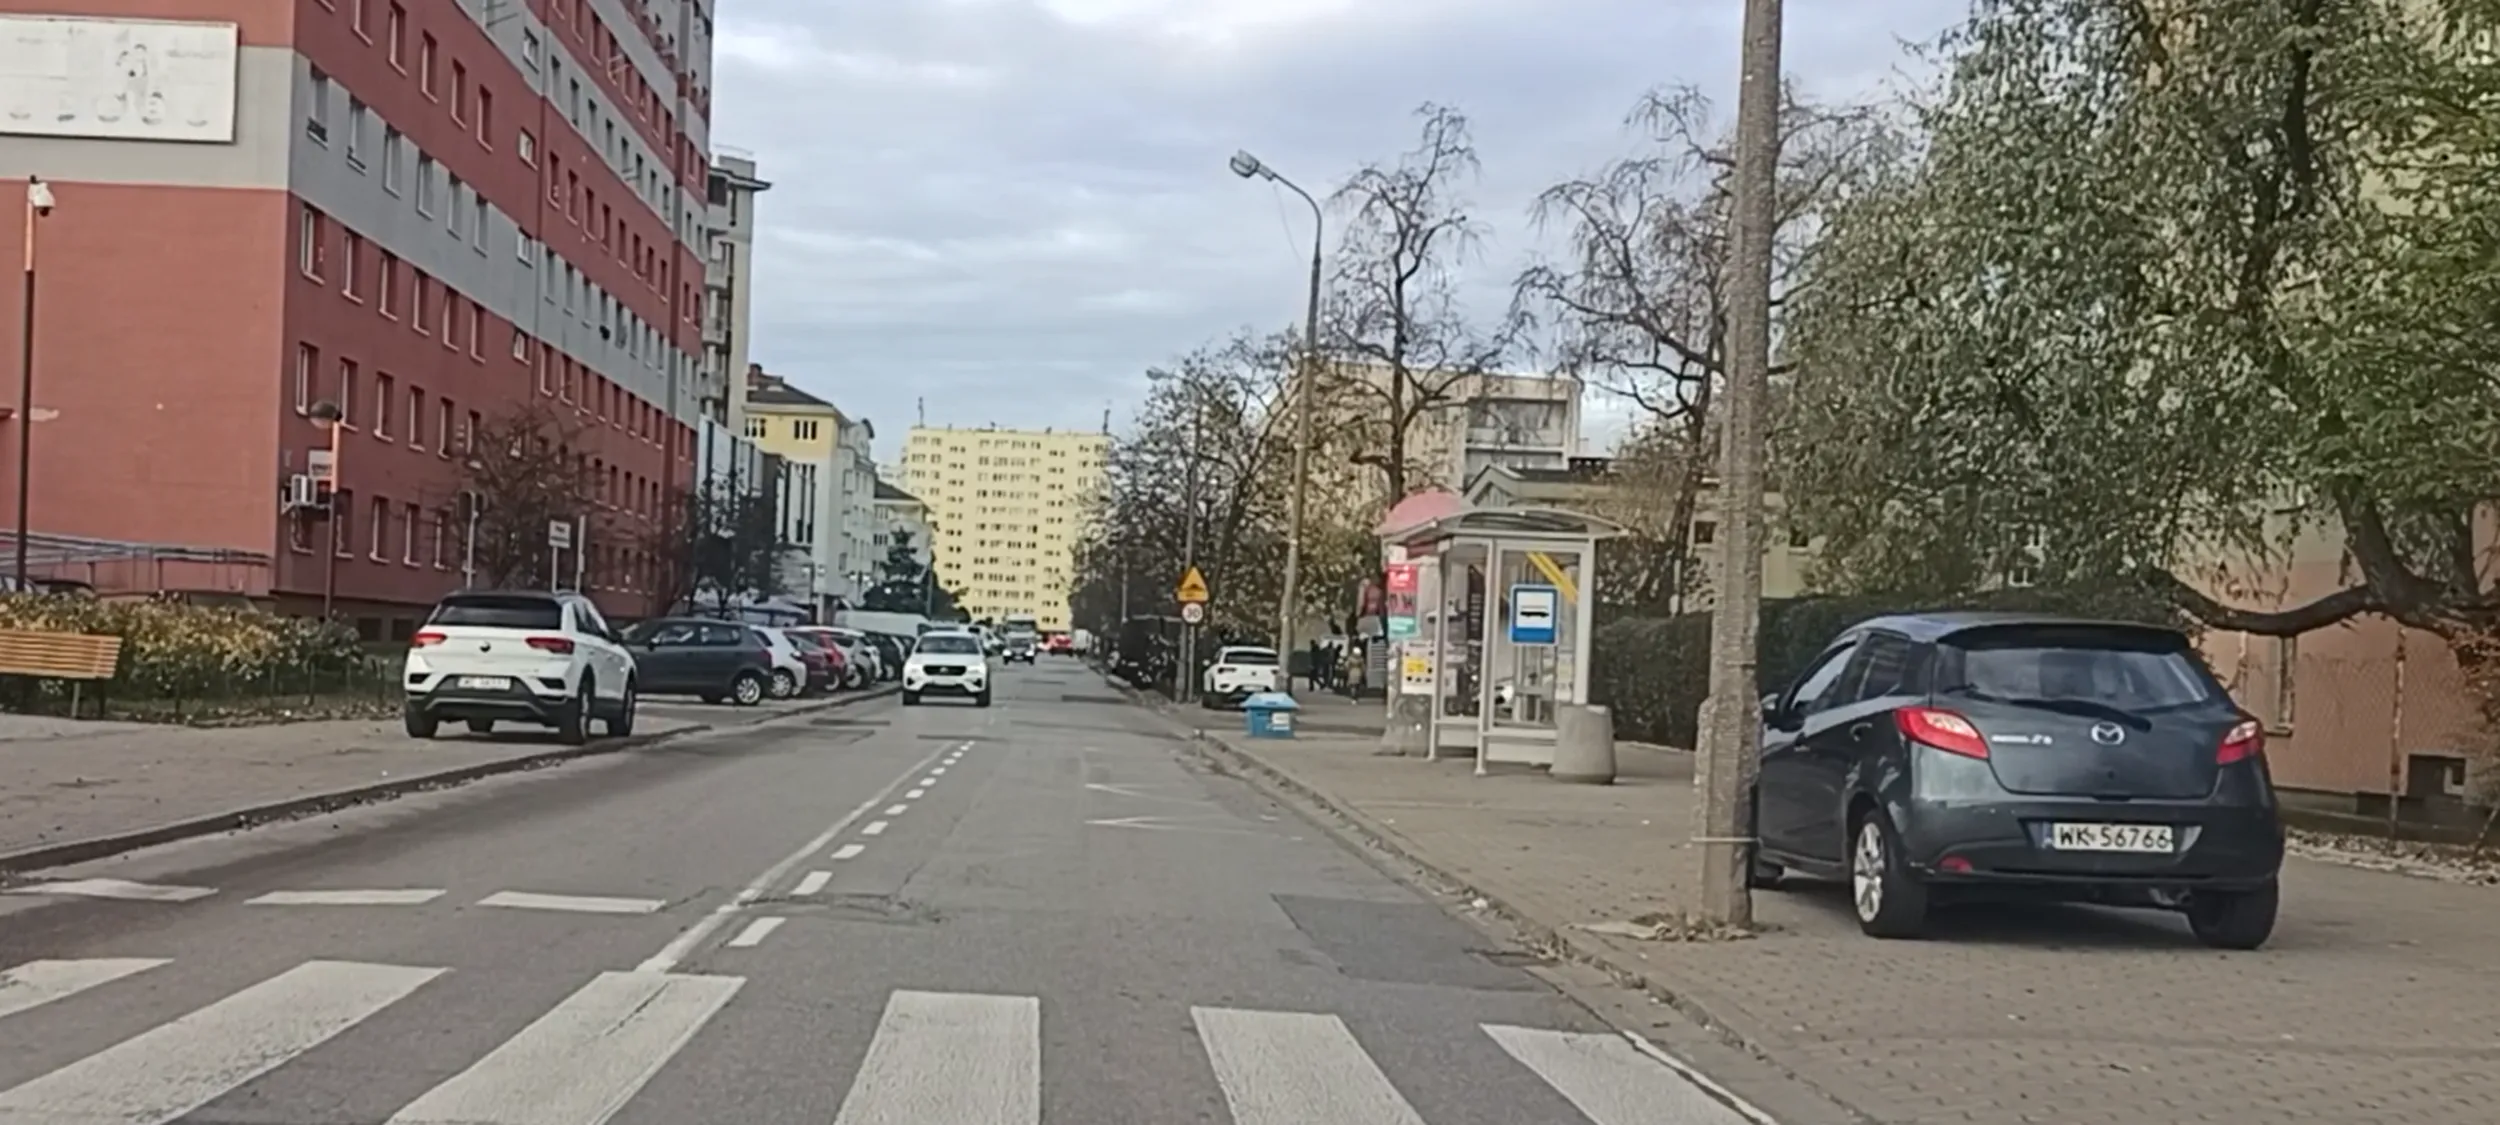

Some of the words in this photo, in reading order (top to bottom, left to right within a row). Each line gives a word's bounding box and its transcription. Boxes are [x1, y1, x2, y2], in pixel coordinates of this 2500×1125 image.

[1187, 607, 1200, 619] 30
[2060, 826, 2090, 847] WK
[2100, 826, 2172, 849] 56766
